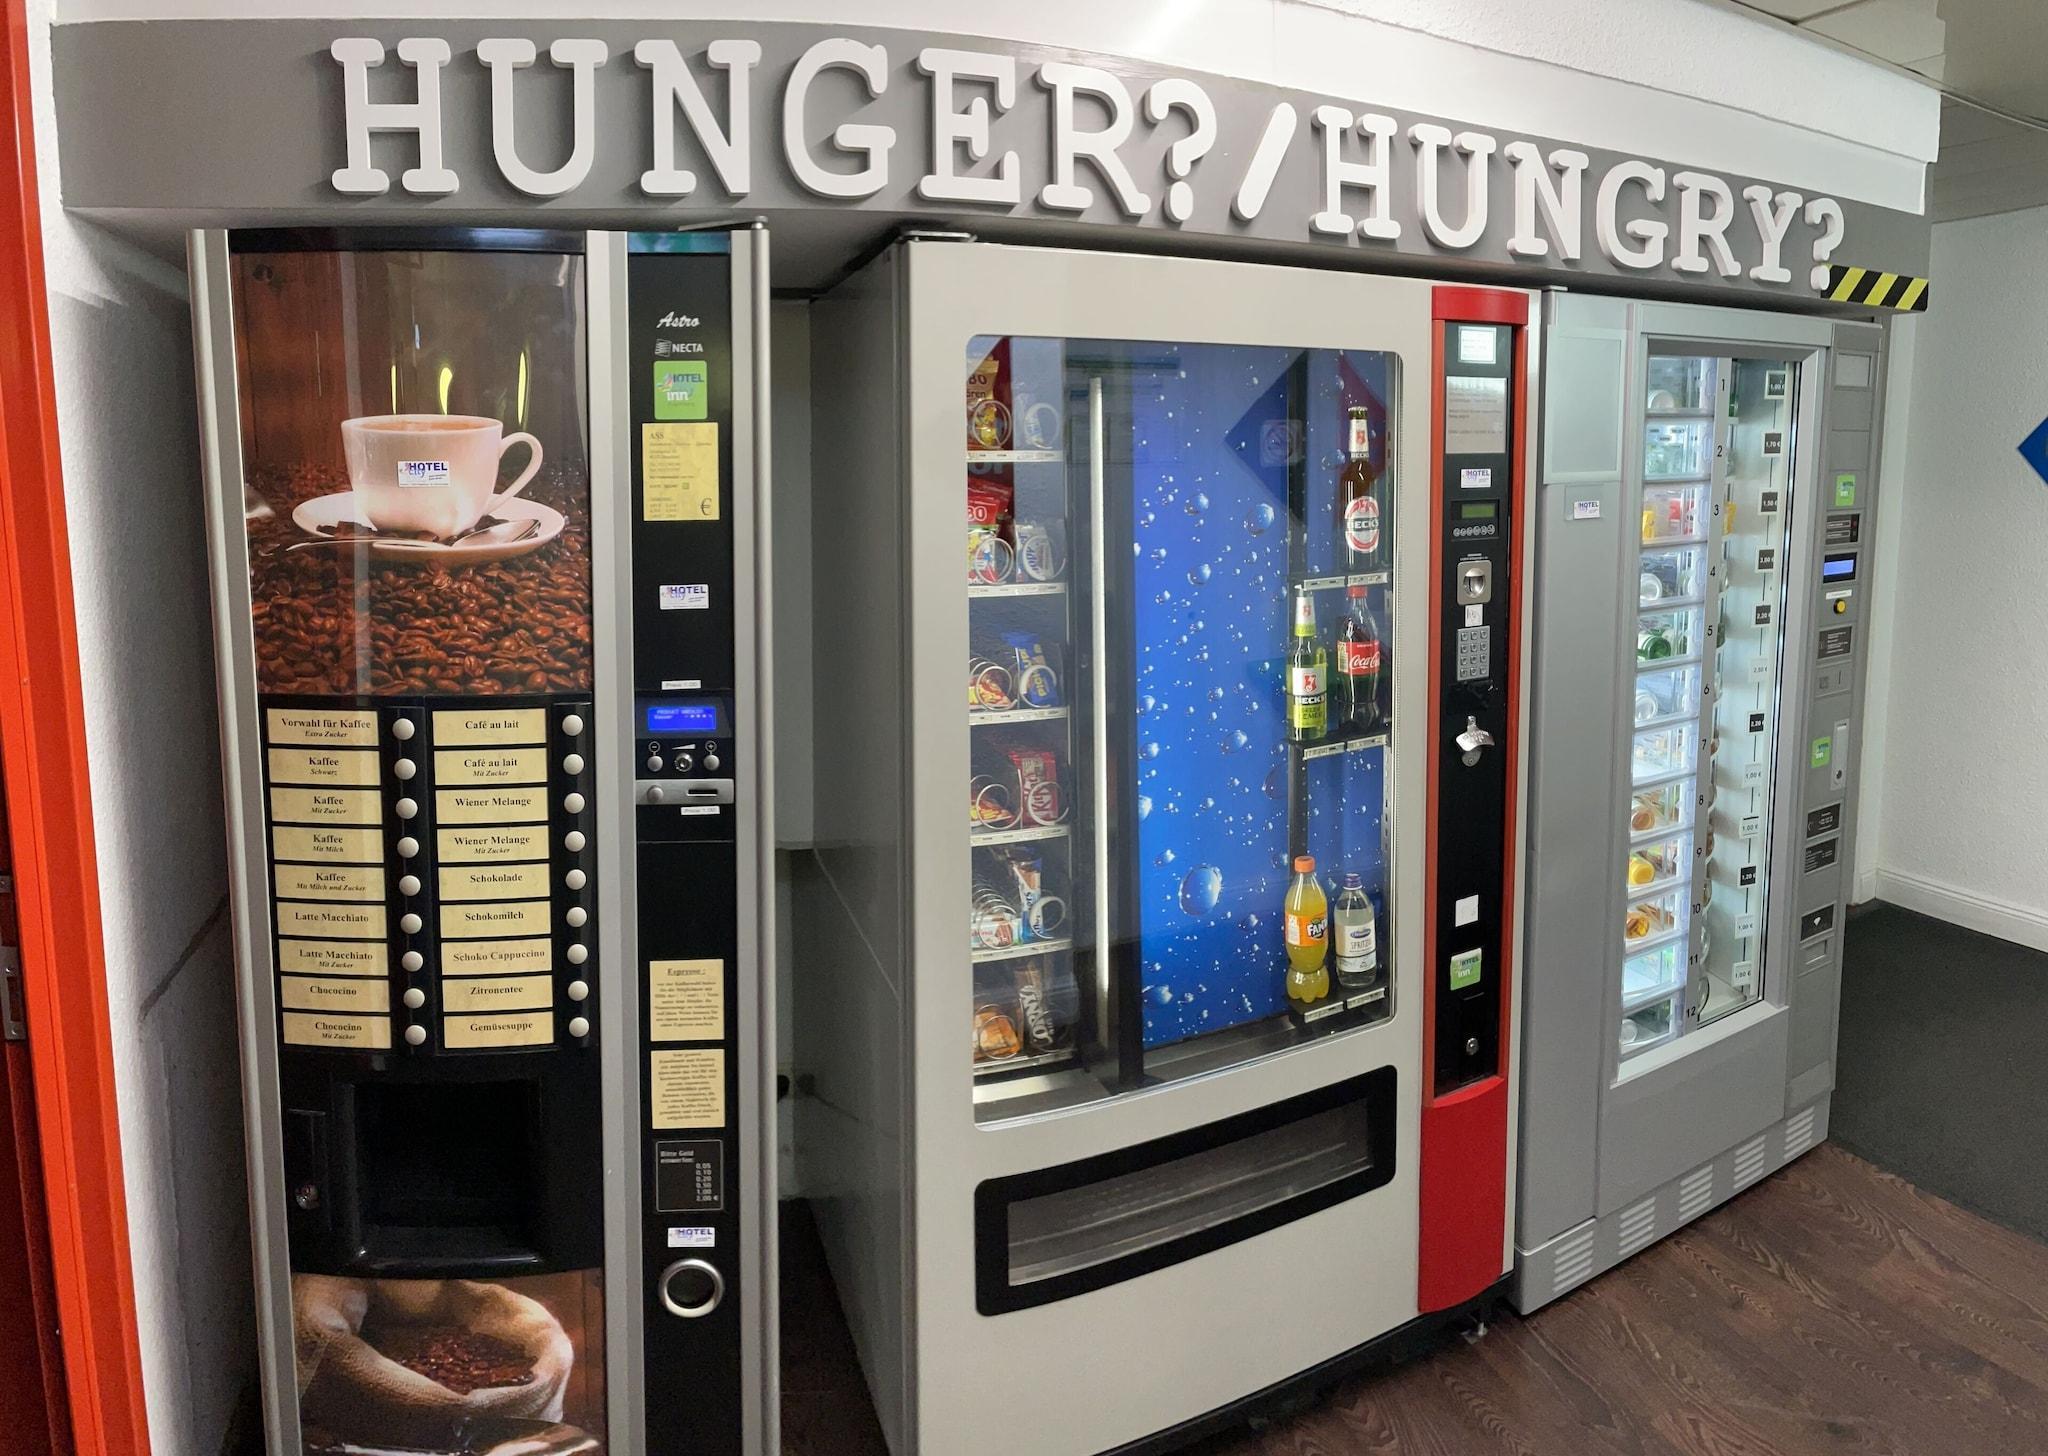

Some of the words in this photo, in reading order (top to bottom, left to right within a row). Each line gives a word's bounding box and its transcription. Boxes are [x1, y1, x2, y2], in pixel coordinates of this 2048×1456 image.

[331, 37, 1217, 222] HUNGER?
[1309, 105, 1845, 291] HUNGRY?
[656, 311, 701, 329] Astro
[672, 343, 704, 353] NECTA
[1721, 379, 1725, 391] 1
[1717, 445, 1723, 457] 2
[409, 462, 448, 471] HOTEL
[1465, 469, 1490, 477] HOTEL
[700, 497, 712, 516] €
[1713, 504, 1719, 516] 3
[1710, 566, 1716, 577] 4
[670, 586, 706, 594] HOTEL
[1707, 625, 1713, 636] 5
[1704, 683, 1710, 695] 6
[281, 718, 320, 728] Vorwahl
[323, 719, 337, 729] für
[340, 719, 372, 729] Kaffee
[465, 720, 487, 730] Café
[503, 720, 520, 729] lait
[1702, 739, 1707, 750] 7
[308, 757, 340, 766] Kaffee
[464, 758, 486, 768] Café
[502, 758, 518, 767] lait
[310, 768, 338, 776] Schwarz
[313, 796, 344, 805] Kaffee
[455, 798, 489, 807] Wiener
[492, 797, 532, 807] Melange
[1698, 795, 1704, 806] 8
[313, 834, 344, 844] Kaffee
[454, 836, 488, 846] Wiener
[490, 836, 531, 846] Melange
[1696, 847, 1702, 858] 9
[316, 872, 346, 882] Kaffee
[470, 873, 523, 884] Schokolade
[343, 884, 366, 892] Zucker
[1692, 904, 1701, 914] 10
[295, 912, 319, 921] Latte
[321, 913, 369, 922] Macchiato
[465, 911, 524, 921] Schokomilch
[299, 949, 323, 959] Latte
[326, 951, 374, 960] Macchiato
[453, 952, 488, 962] Schoko
[490, 949, 545, 962] Cappuccino
[1689, 954, 1698, 966] 11
[309, 985, 357, 995] Chococino
[470, 986, 524, 995] Zitronentee
[1686, 1006, 1696, 1018] 12
[315, 1021, 362, 1031] Chococino
[470, 1021, 534, 1032] Gemüsesuppe
[678, 1228, 712, 1236] HOTEL
